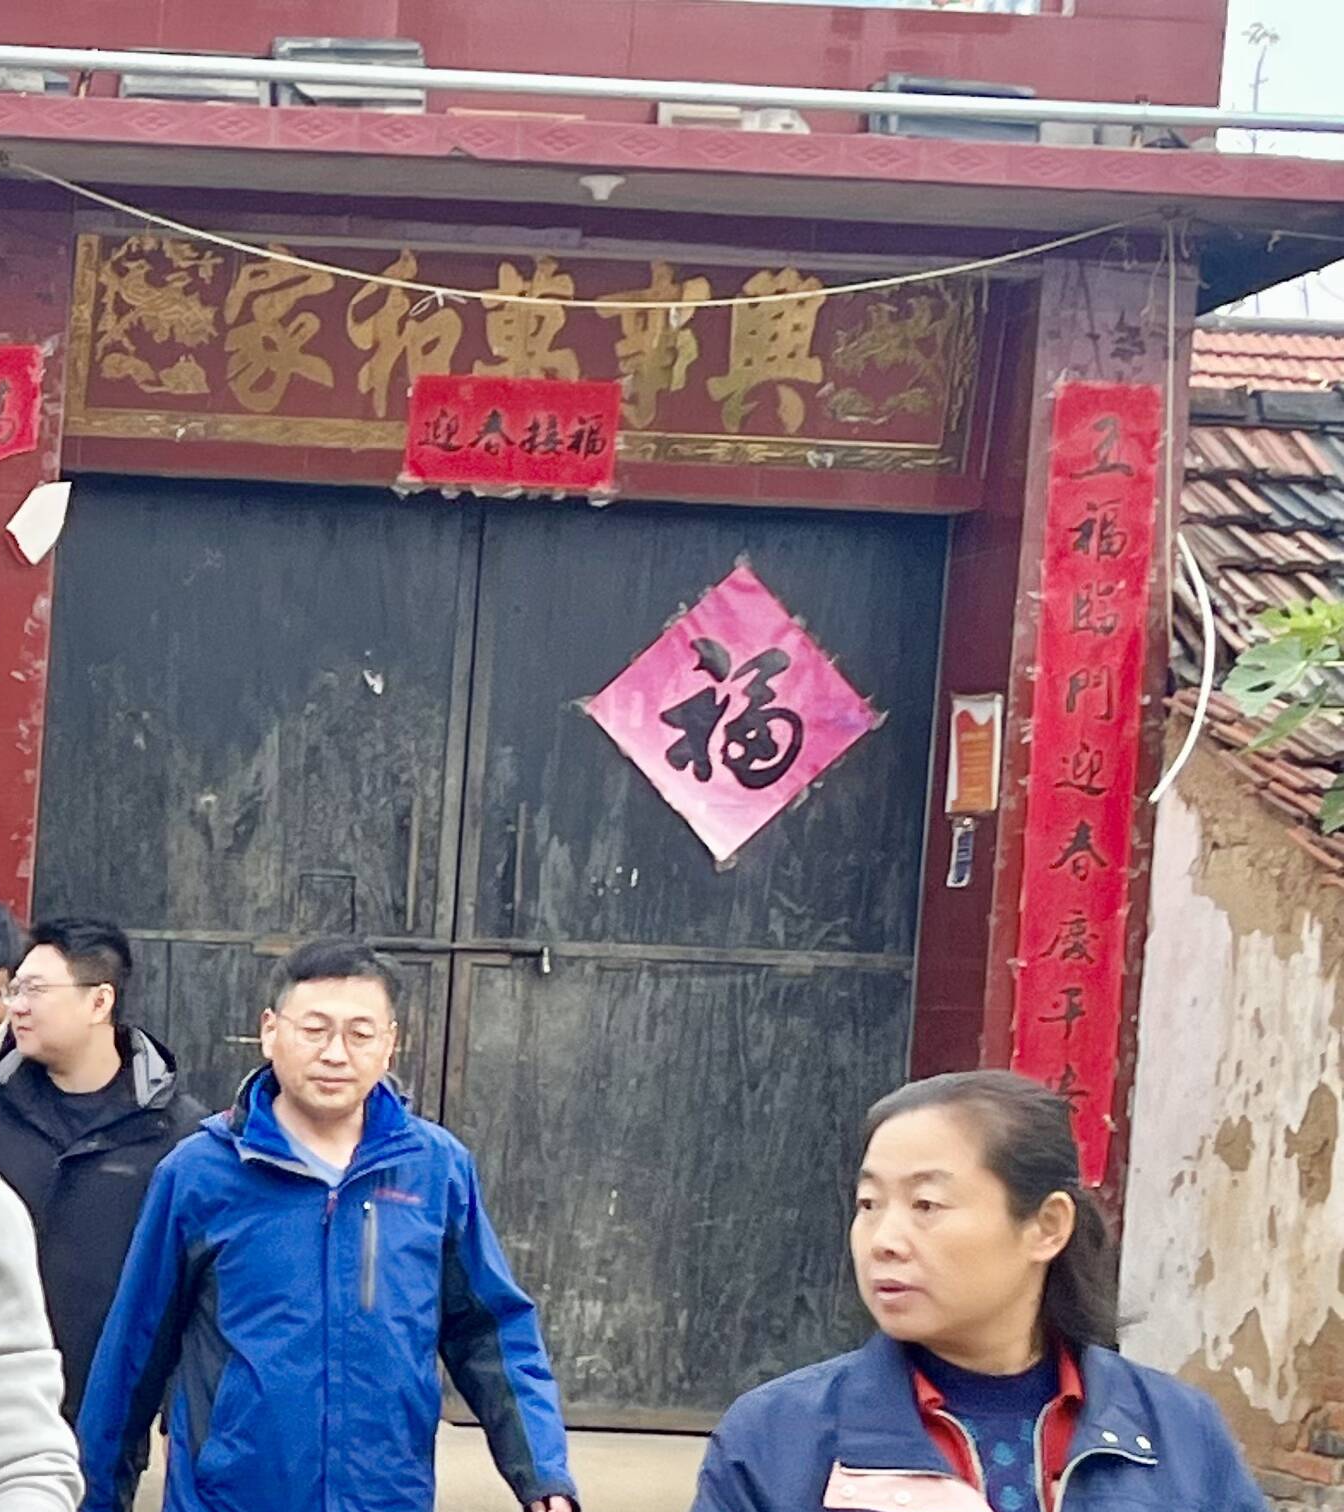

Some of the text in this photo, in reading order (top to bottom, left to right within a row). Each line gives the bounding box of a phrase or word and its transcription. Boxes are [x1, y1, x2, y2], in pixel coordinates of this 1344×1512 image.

[418, 408, 608, 459] 迎春接福
[659, 636, 804, 790] 福
